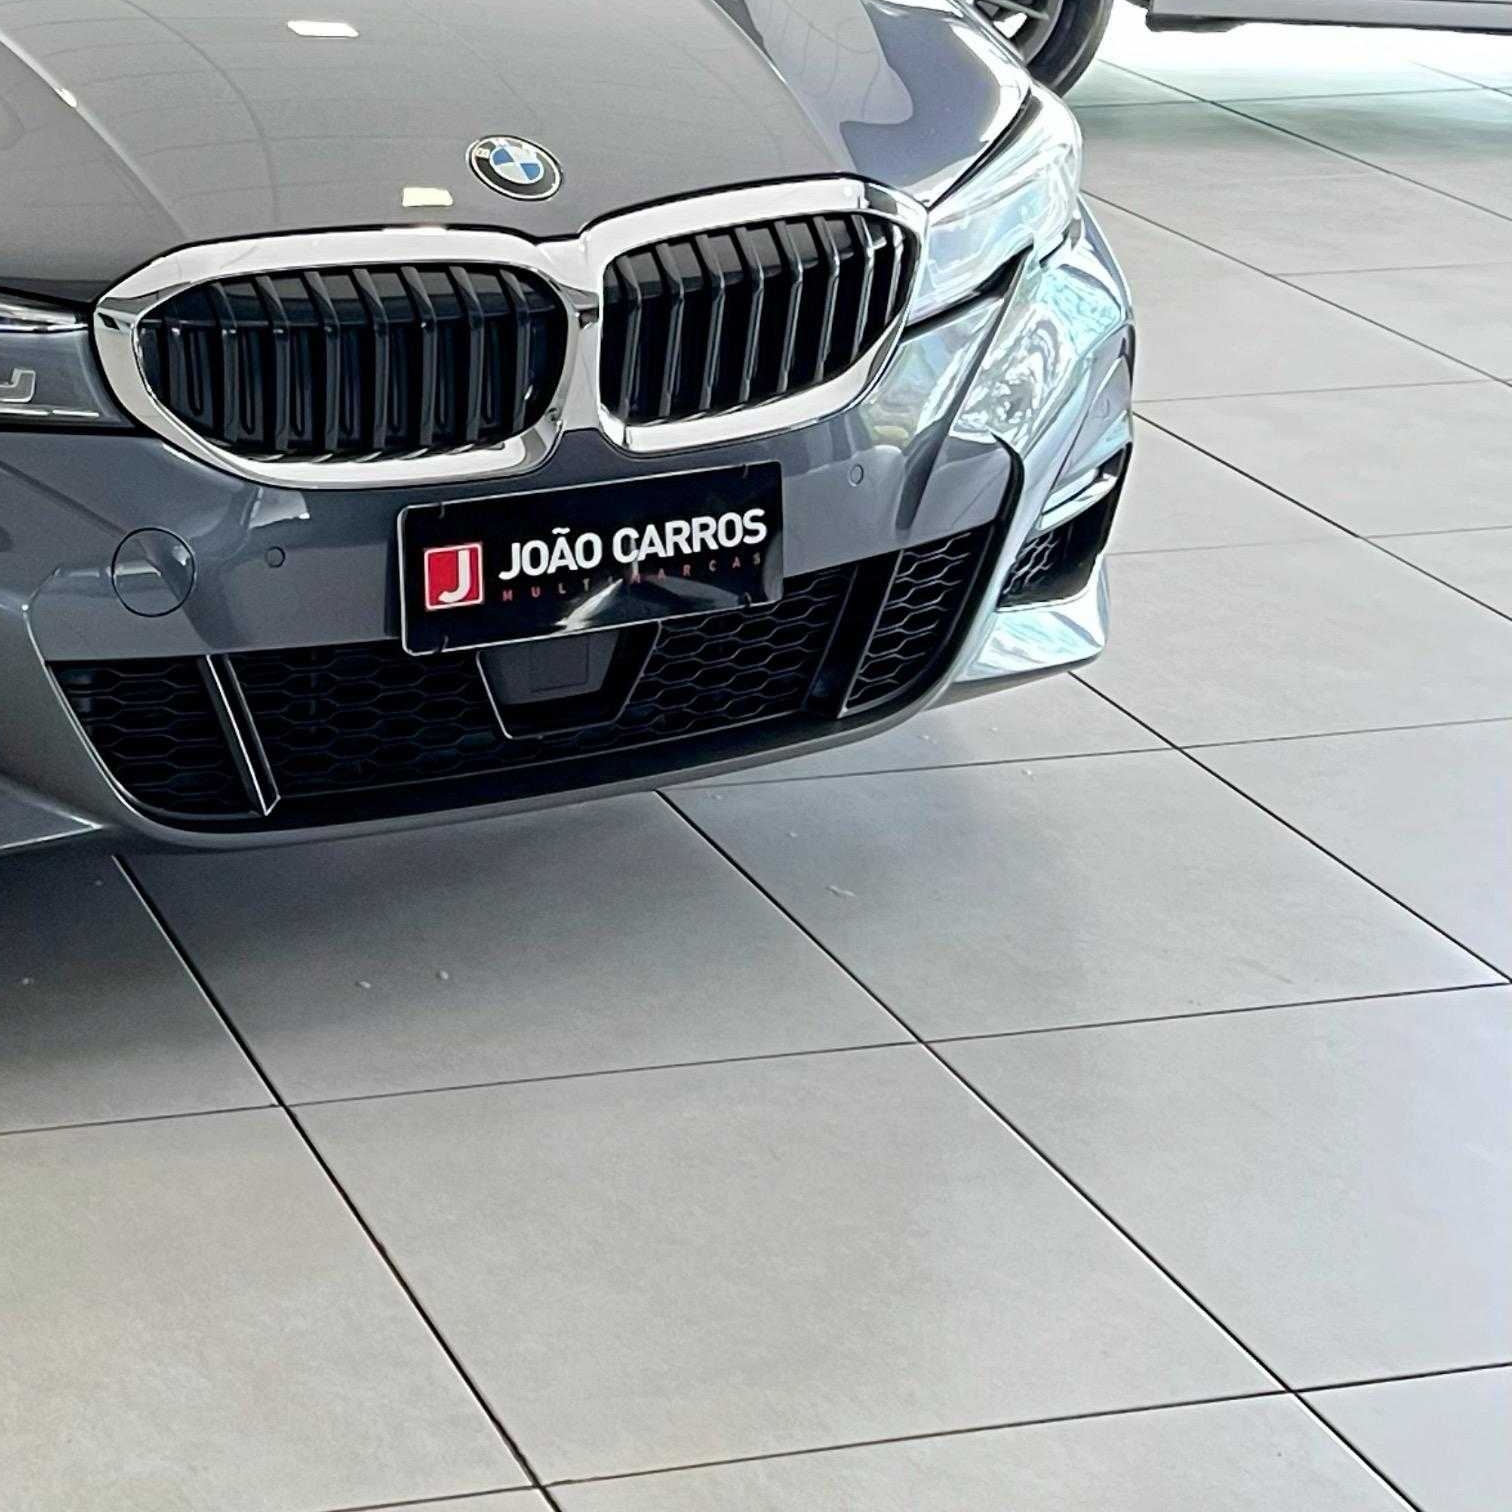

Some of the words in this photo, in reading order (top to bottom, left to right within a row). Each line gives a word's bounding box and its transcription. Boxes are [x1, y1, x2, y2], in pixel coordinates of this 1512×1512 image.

[498, 527, 603, 580] JOÃO
[612, 508, 768, 563] CARROS
[438, 549, 470, 603] J
